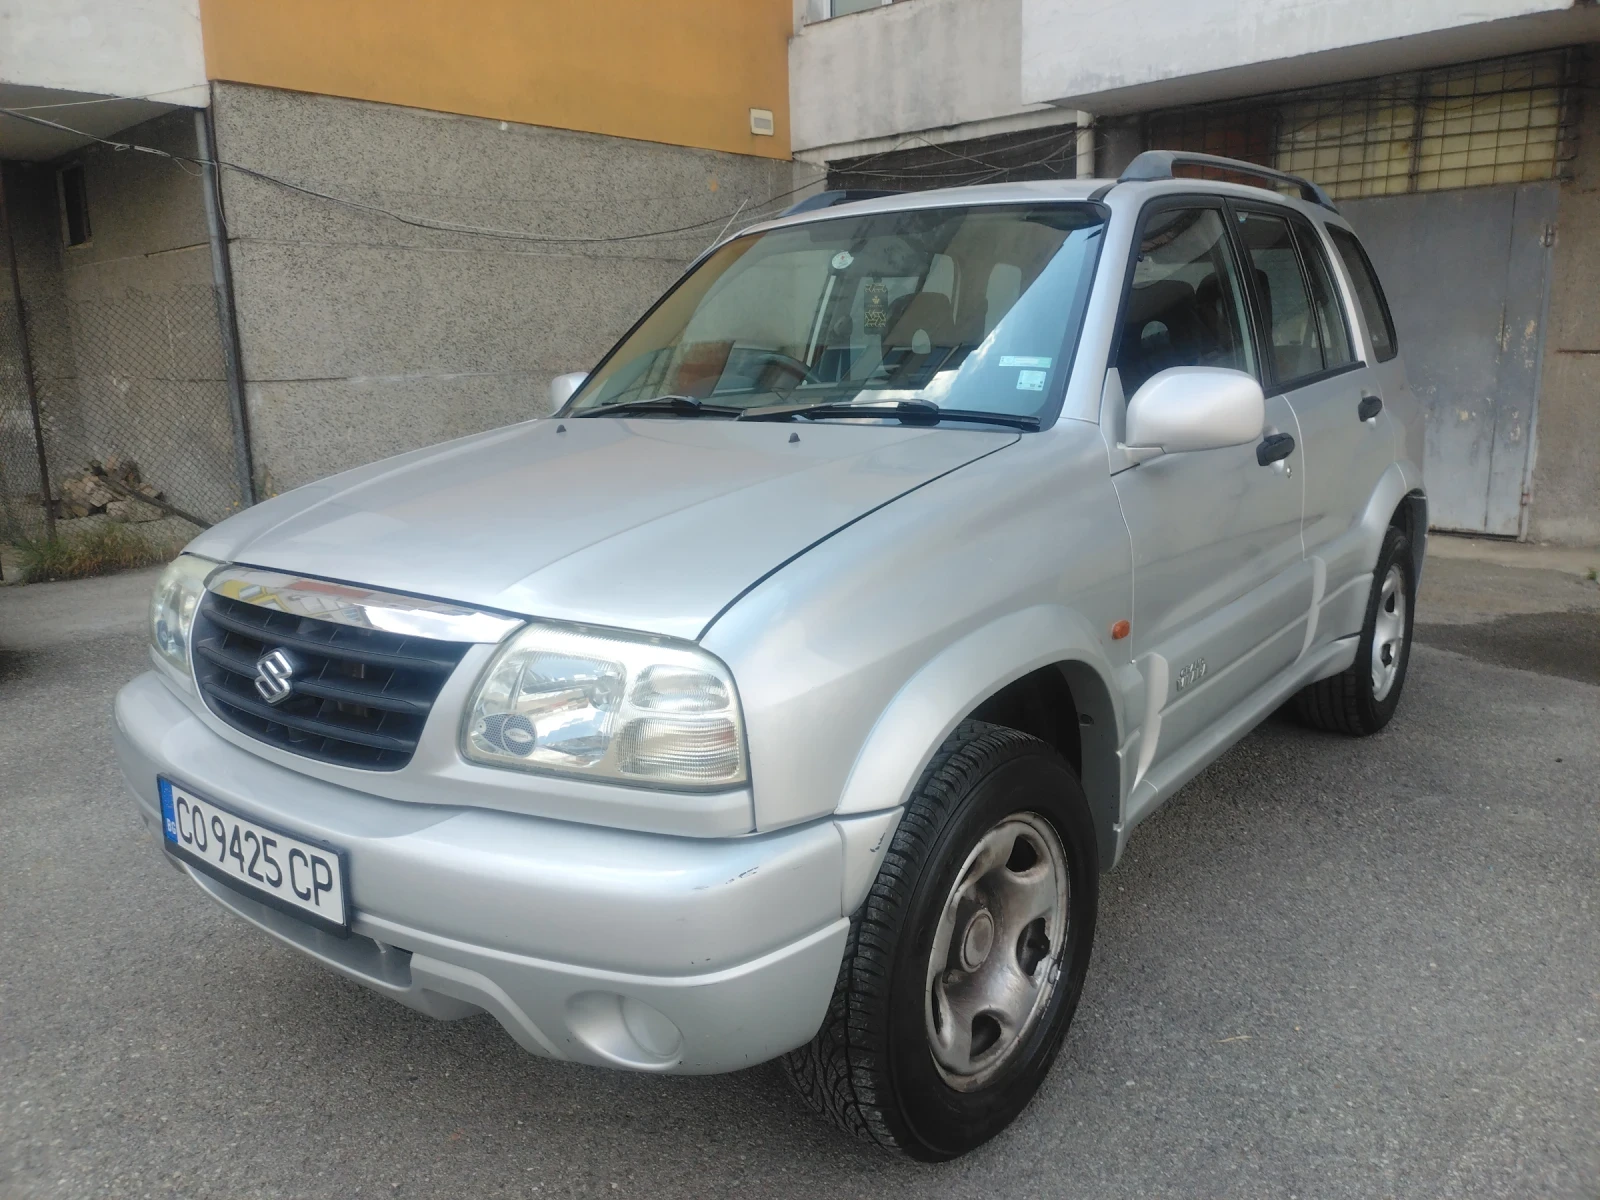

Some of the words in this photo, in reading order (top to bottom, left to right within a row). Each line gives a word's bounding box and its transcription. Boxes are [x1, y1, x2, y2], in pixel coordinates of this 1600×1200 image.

[166, 817, 177, 835] BG
[176, 796, 208, 852] CO
[211, 815, 283, 888] 9425
[288, 848, 333, 906] CP
